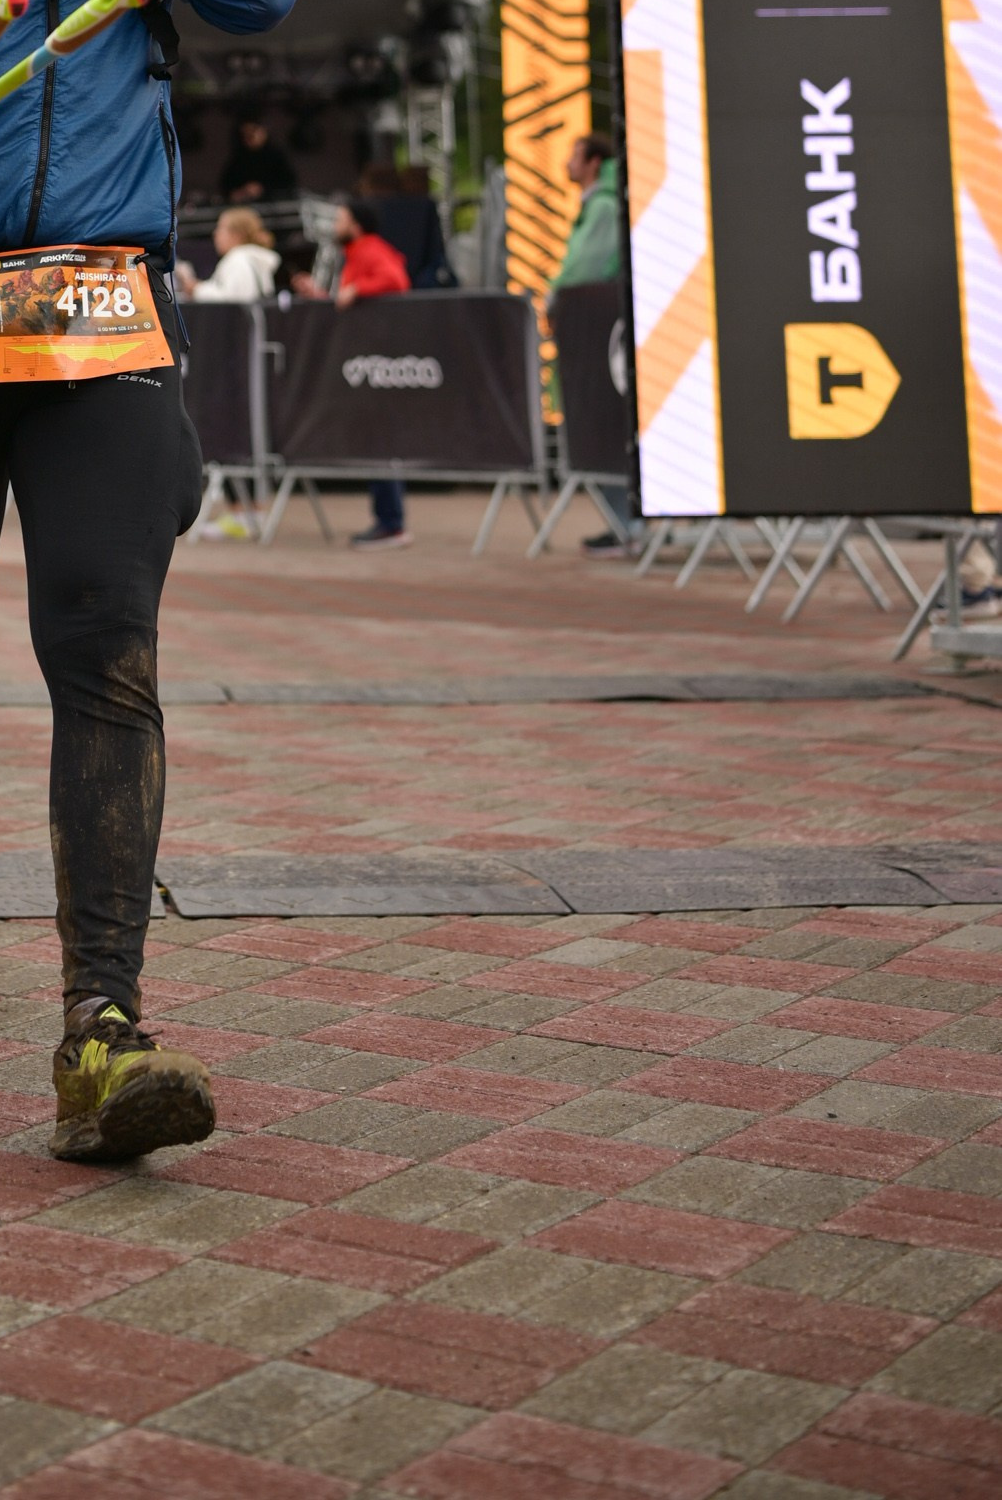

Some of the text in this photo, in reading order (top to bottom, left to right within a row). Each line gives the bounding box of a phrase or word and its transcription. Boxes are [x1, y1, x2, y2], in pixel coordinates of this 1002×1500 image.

[799, 76, 863, 303] БАНК
[2, 259, 26, 268] БАНК
[39, 253, 75, 264] ARKHYZ
[74, 272, 115, 282] ABISHIRA
[115, 273, 127, 282] 40
[56, 285, 136, 318] 4128
[116, 374, 163, 388] DEMIX
